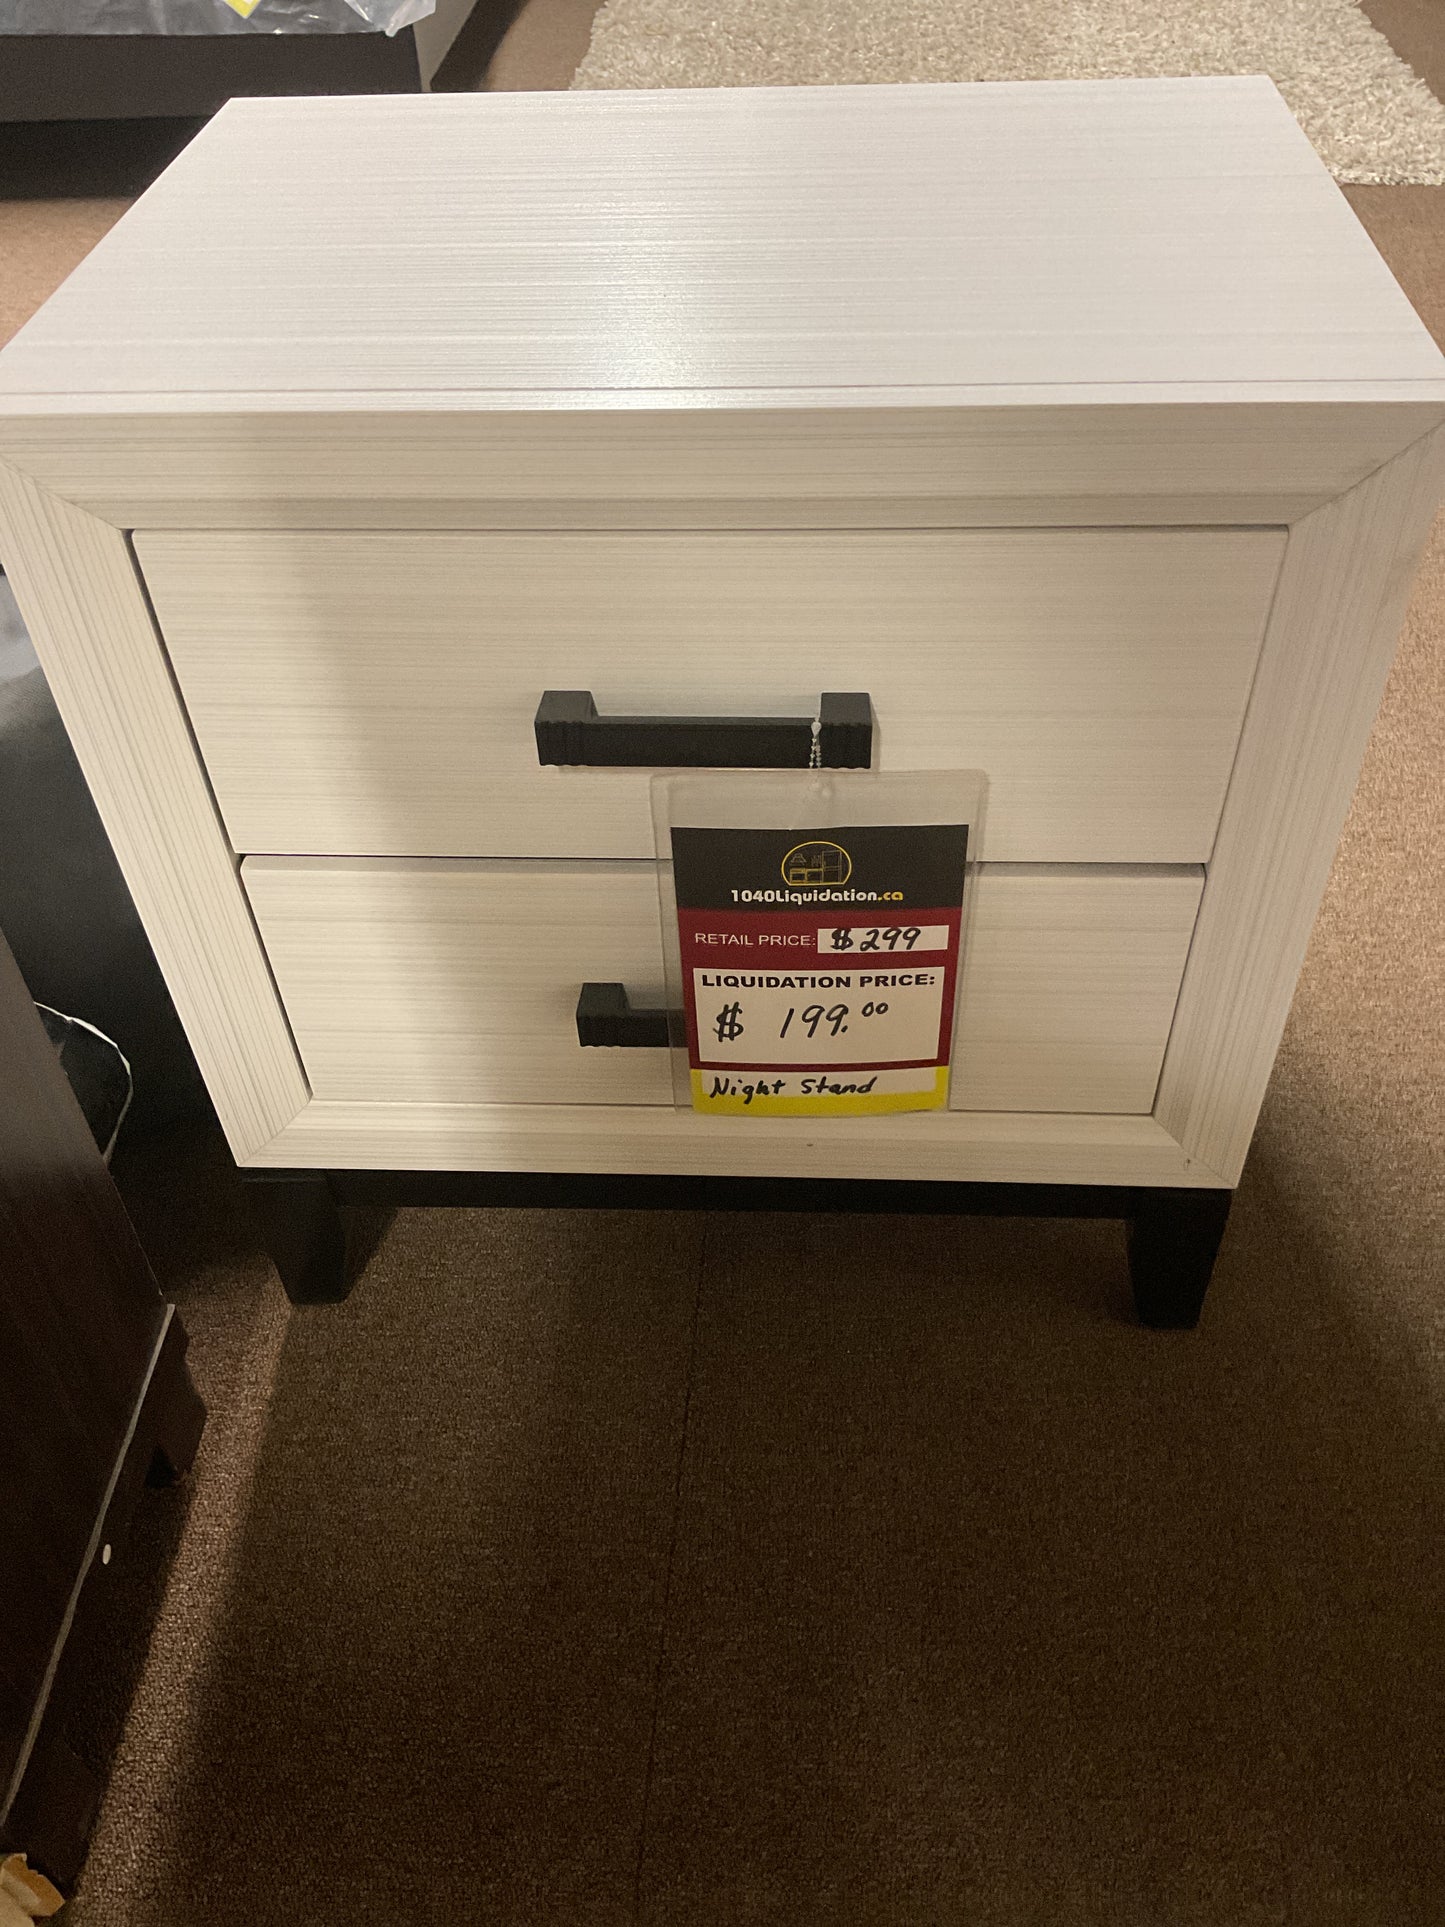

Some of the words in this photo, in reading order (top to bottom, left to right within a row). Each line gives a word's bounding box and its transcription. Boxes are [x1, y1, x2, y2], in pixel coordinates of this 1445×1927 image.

[731, 889, 904, 905] 1040Liquidation.ca
[695, 933, 754, 946] RETAIL
[758, 934, 817, 947] PRICE:
[701, 974, 851, 989] LIQUIDATION
[859, 973, 936, 988] PRICE:
[712, 1001, 745, 1042] $
[709, 1075, 786, 1105] Night
[800, 1075, 878, 1094] Stand
